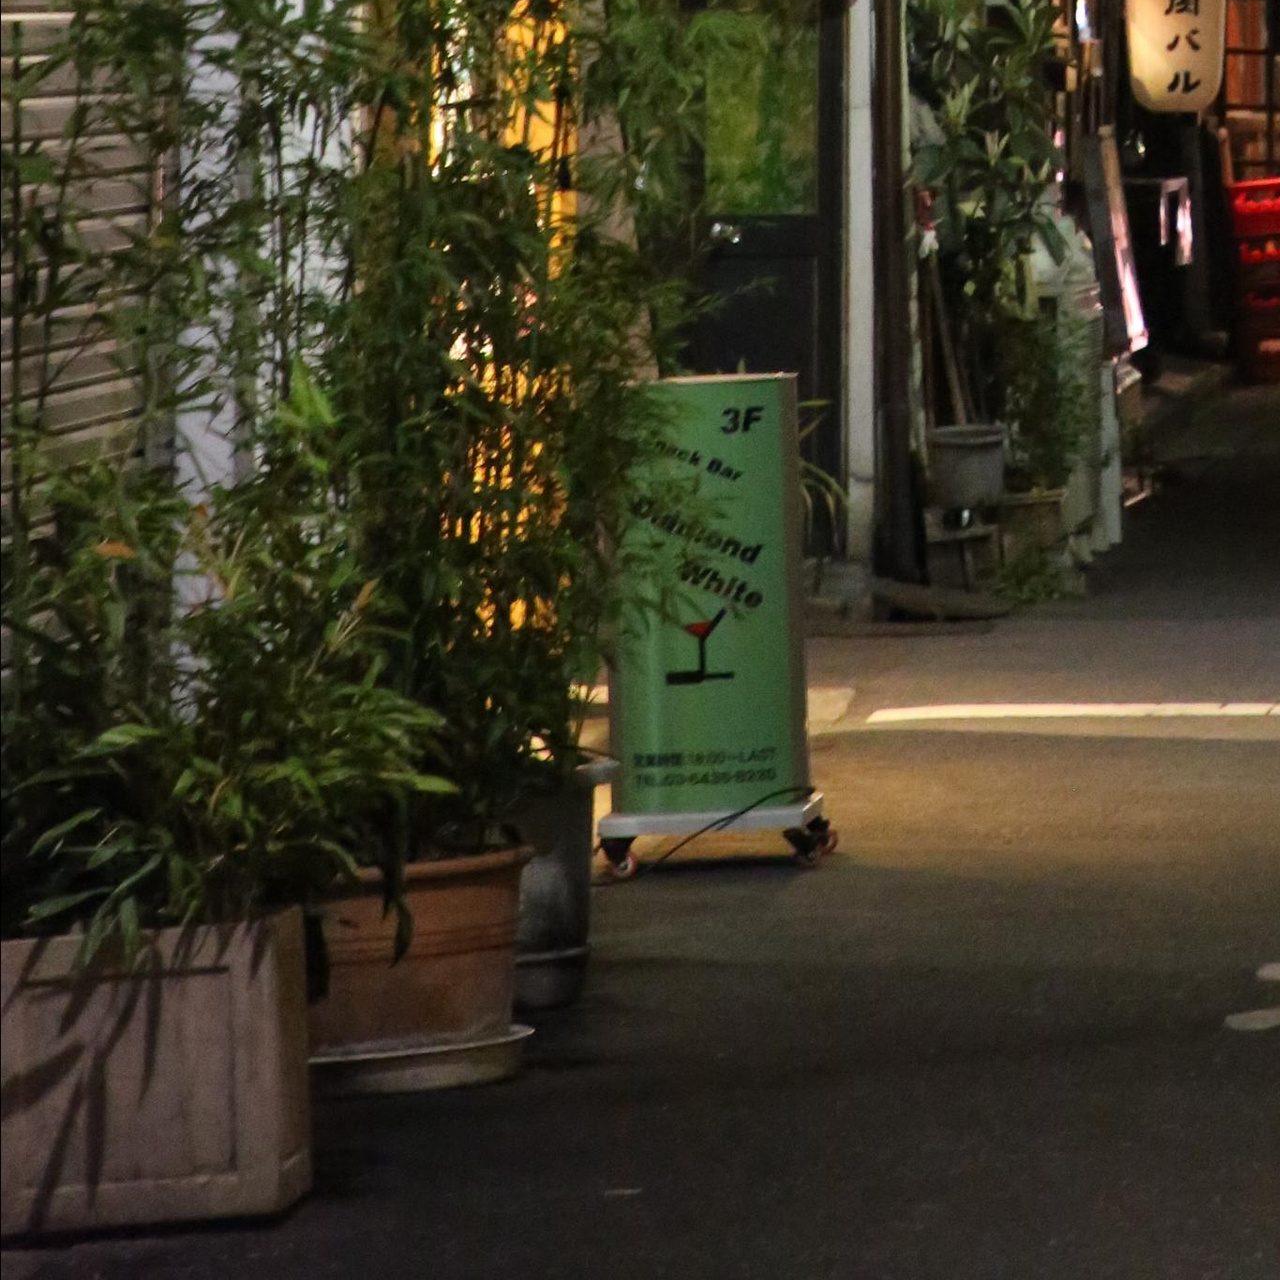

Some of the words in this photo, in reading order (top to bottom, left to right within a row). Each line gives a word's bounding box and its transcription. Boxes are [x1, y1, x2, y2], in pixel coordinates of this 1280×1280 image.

[720, 405, 765, 435] 3F
[705, 457, 744, 482] Bar
[680, 560, 764, 609] White
